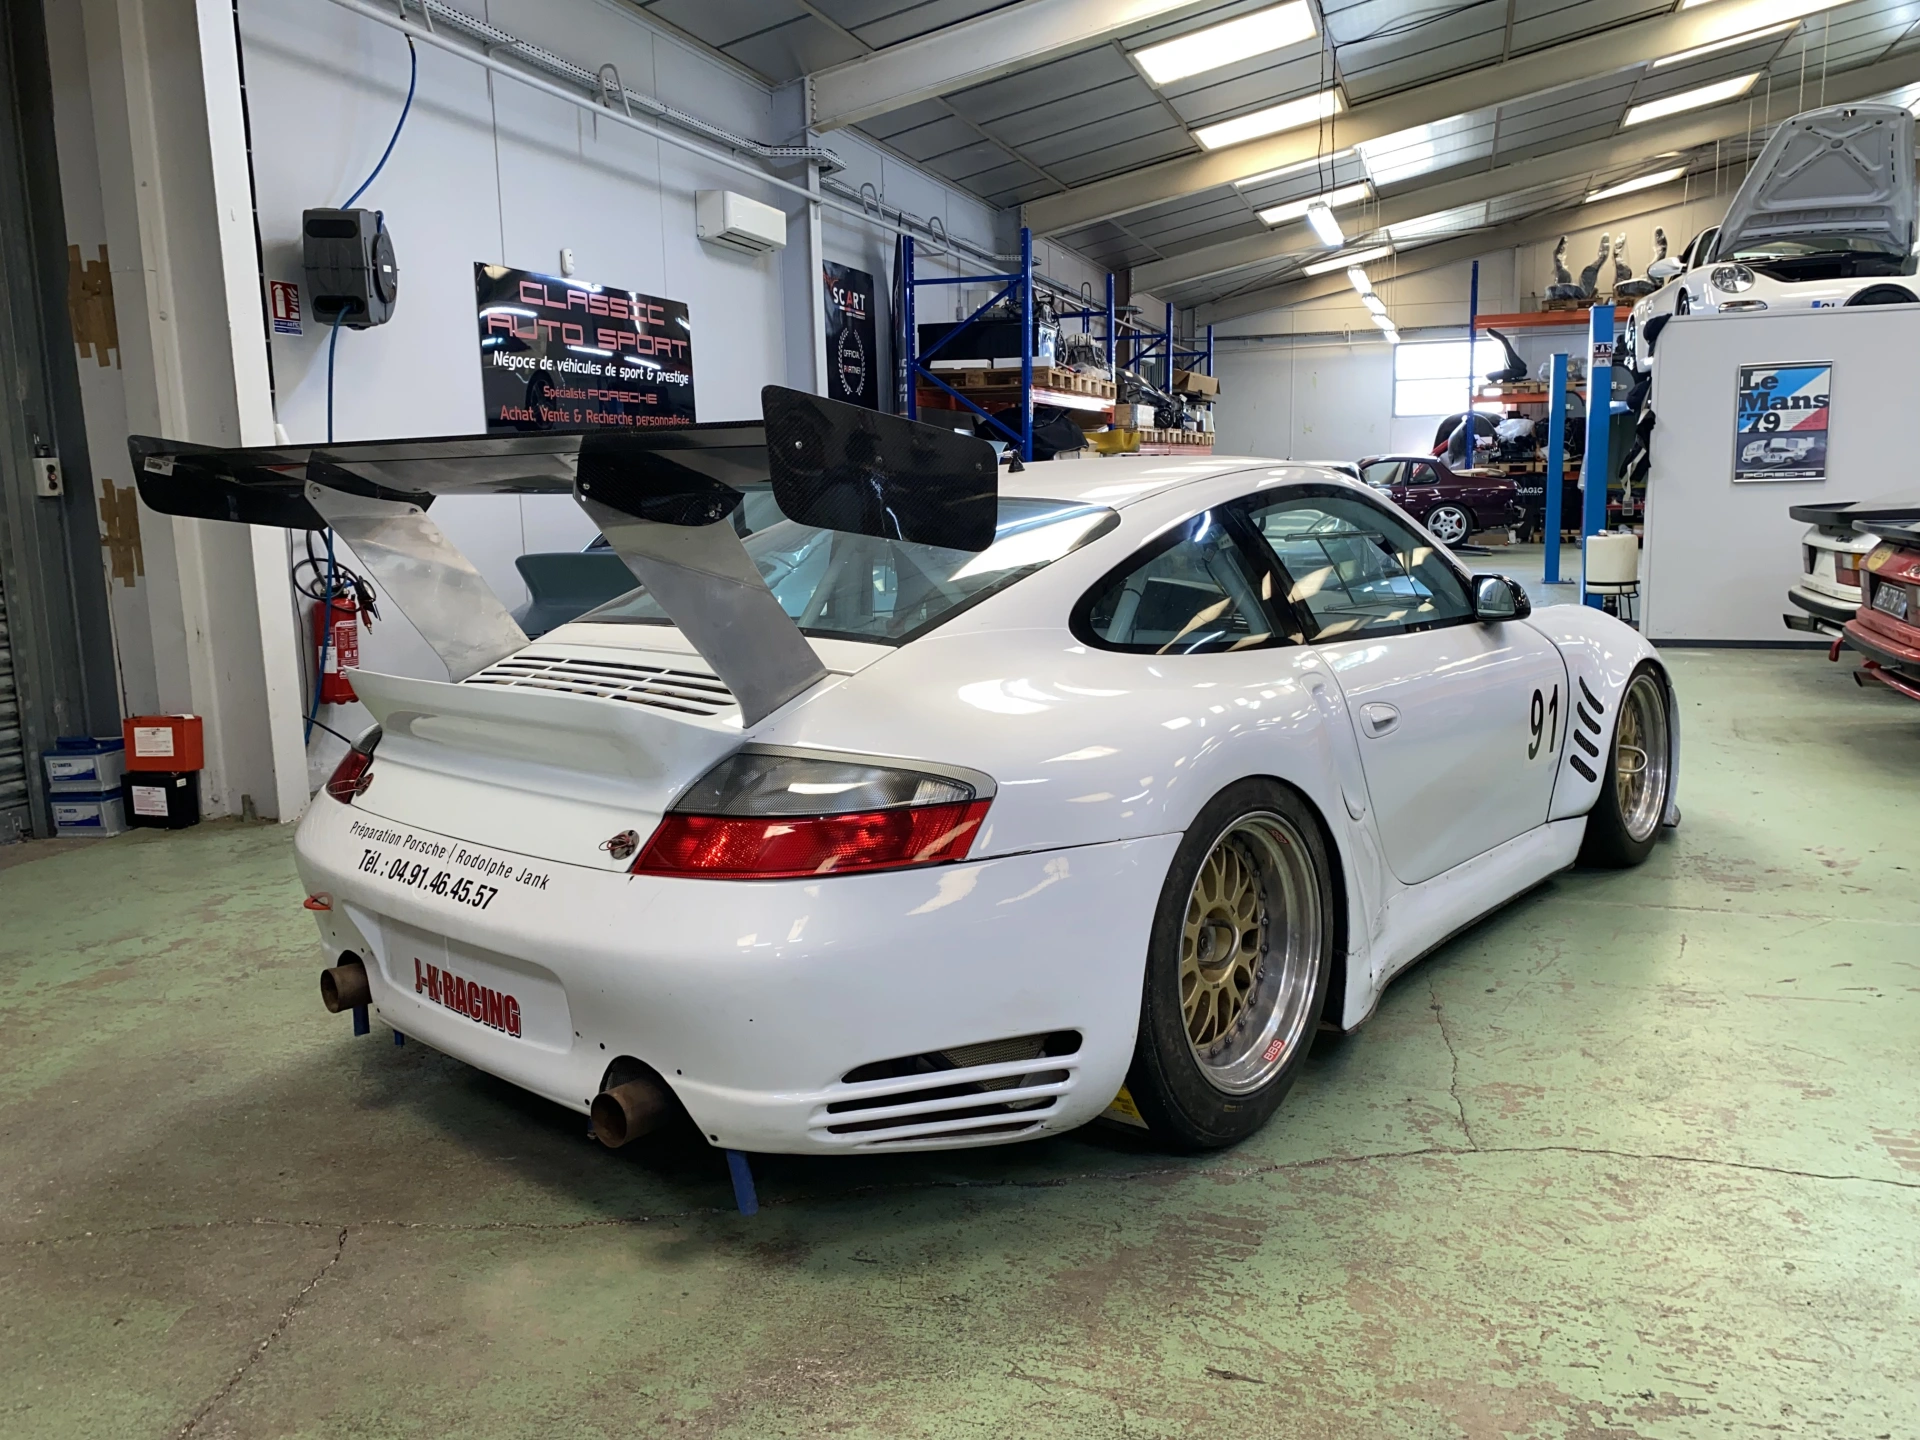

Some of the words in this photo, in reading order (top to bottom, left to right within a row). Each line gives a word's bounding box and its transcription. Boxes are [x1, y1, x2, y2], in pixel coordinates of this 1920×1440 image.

[519, 280, 665, 326] CLASSIC
[832, 286, 866, 311] SCART
[487, 312, 584, 345] AUTO
[597, 328, 687, 359] SPORT
[1593, 344, 1612, 353] CAS
[493, 350, 536, 371] Négoce
[539, 356, 553, 371] de
[556, 357, 601, 376] véhicules
[605, 362, 617, 377] de
[619, 366, 644, 381] sport
[646, 368, 654, 381] &
[656, 370, 689, 387] prestige
[1740, 369, 1779, 391] Le
[543, 385, 587, 400] Spécialiste
[587, 388, 658, 405] PORSCHE
[1739, 391, 1829, 412] Mans
[540, 406, 570, 423] Vente
[573, 409, 582, 423] &
[586, 410, 633, 426] Recherche
[1528, 683, 1559, 760] 91
[350, 821, 402, 846] Préparation
[403, 834, 446, 859] Porsche
[455, 849, 513, 879] Rodolphe
[515, 867, 550, 890] Jank
[388, 858, 498, 910] 04.91.46.45.57
[1263, 1039, 1283, 1061] BBS
